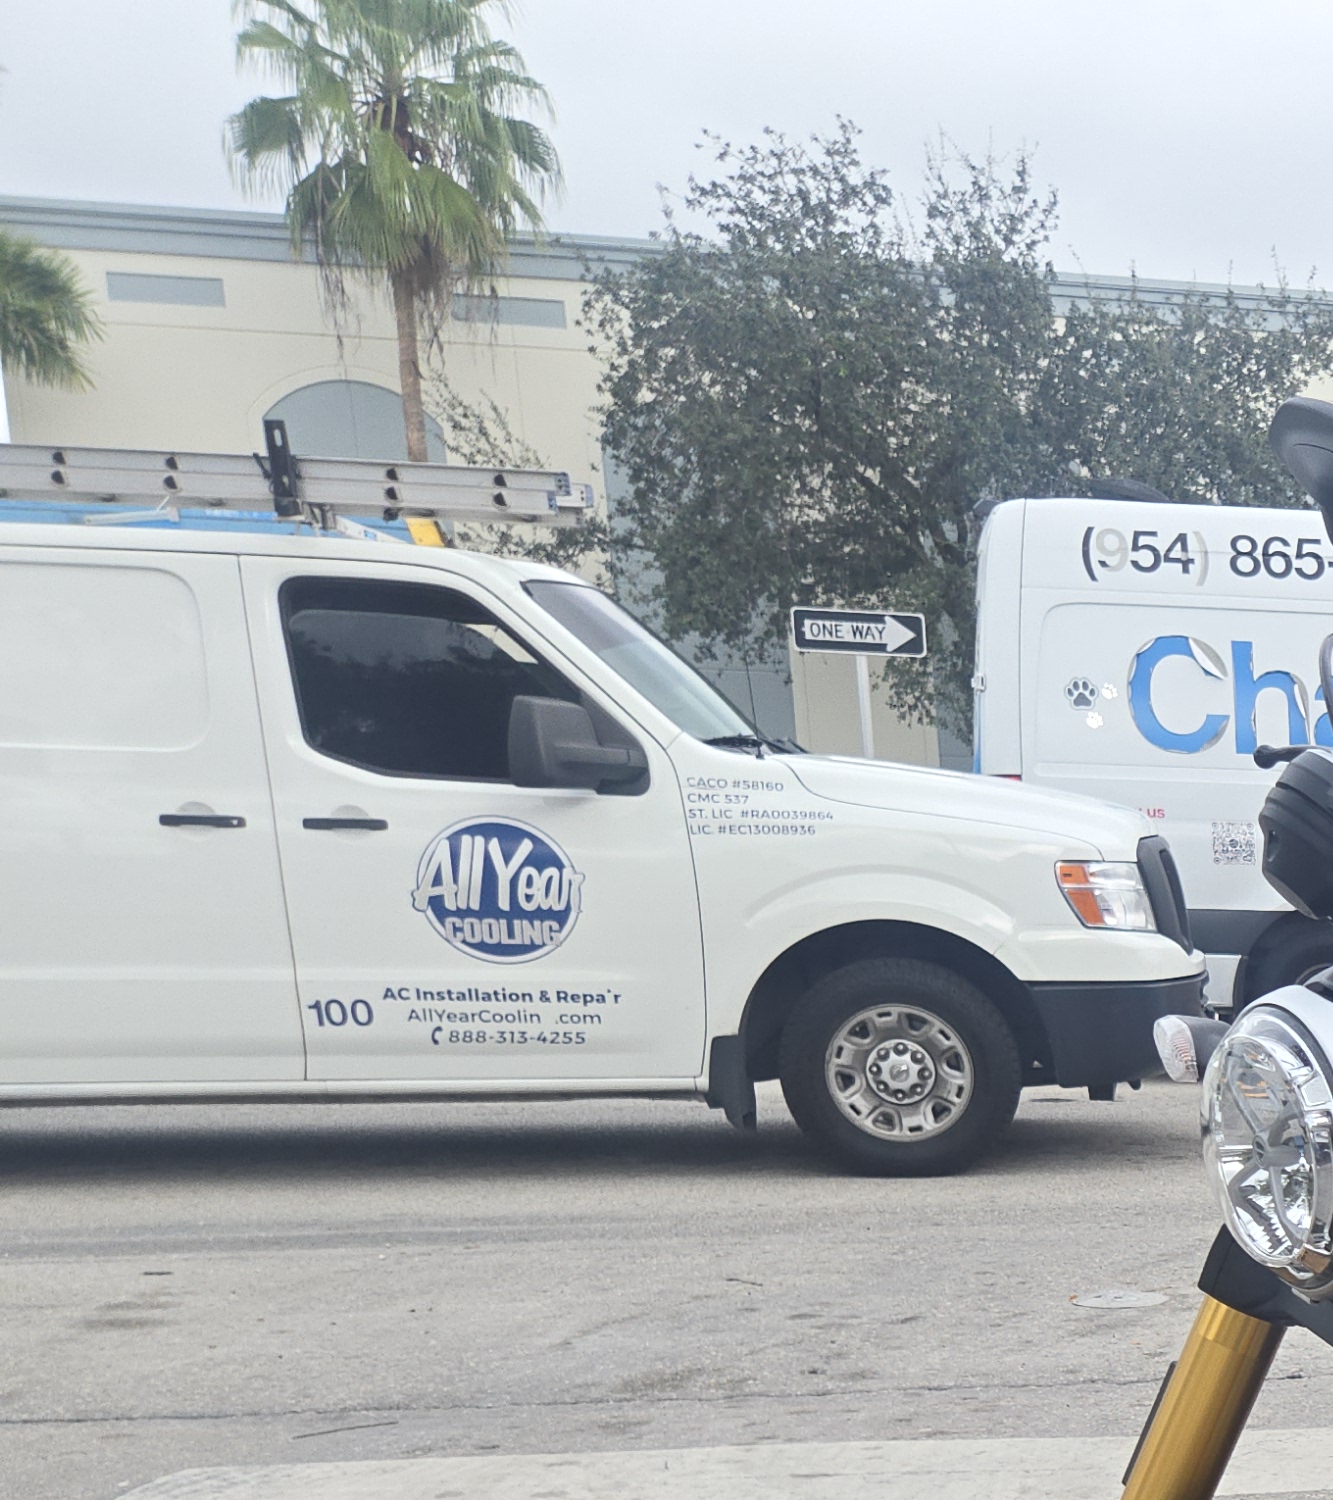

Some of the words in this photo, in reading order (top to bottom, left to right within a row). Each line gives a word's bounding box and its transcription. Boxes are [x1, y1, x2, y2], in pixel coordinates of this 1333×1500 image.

[1082, 526, 1209, 587] (954)
[810, 622, 845, 638] ONE
[851, 624, 886, 640] WAY
[686, 777, 728, 789] CACO
[687, 793, 720, 804] CMC
[688, 809, 708, 819] ST.
[1147, 808, 1165, 819] us
[444, 917, 562, 947] COOLING
[382, 987, 410, 1002] AC
[415, 987, 533, 1003] Installation
[539, 989, 552, 1003] &
[556, 988, 622, 1007] Repar
[307, 998, 375, 1028] 100
[449, 1030, 587, 1045] 888-313-4255
